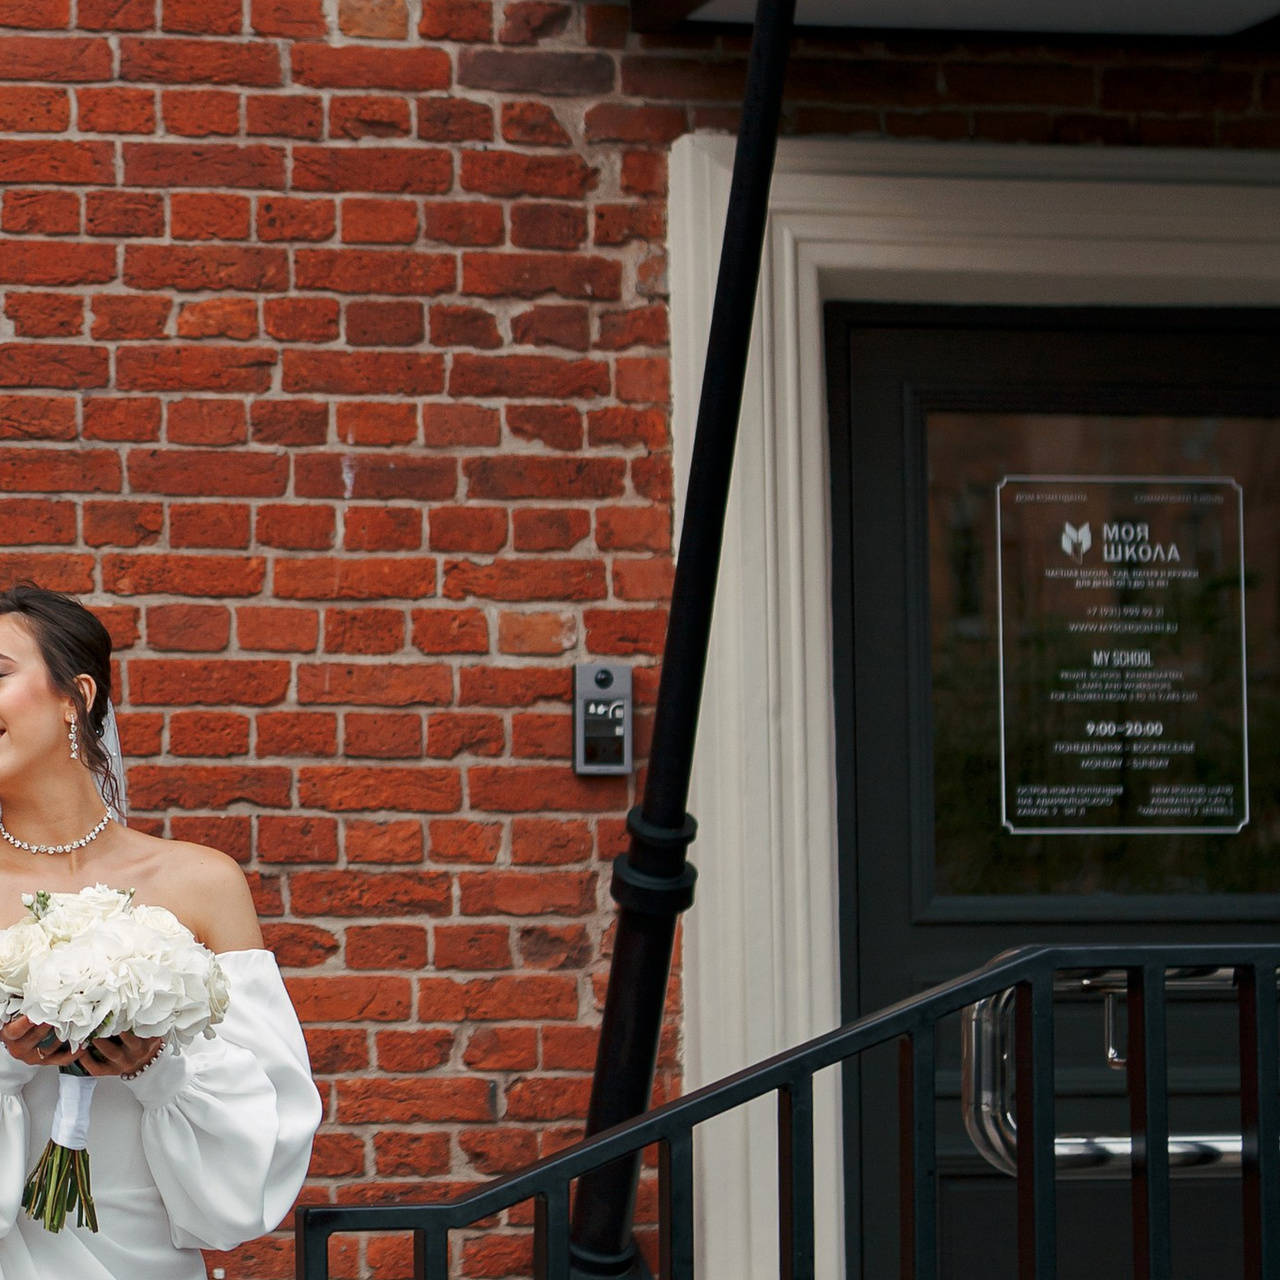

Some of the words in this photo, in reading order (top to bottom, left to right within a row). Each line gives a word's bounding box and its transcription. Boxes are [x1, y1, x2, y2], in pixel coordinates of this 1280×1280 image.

[1103, 523, 1149, 542] МОЯ
[1103, 544, 1180, 562] ШКОЛА
[1093, 650, 1110, 666] MY
[1113, 650, 1153, 667] SCHOOL
